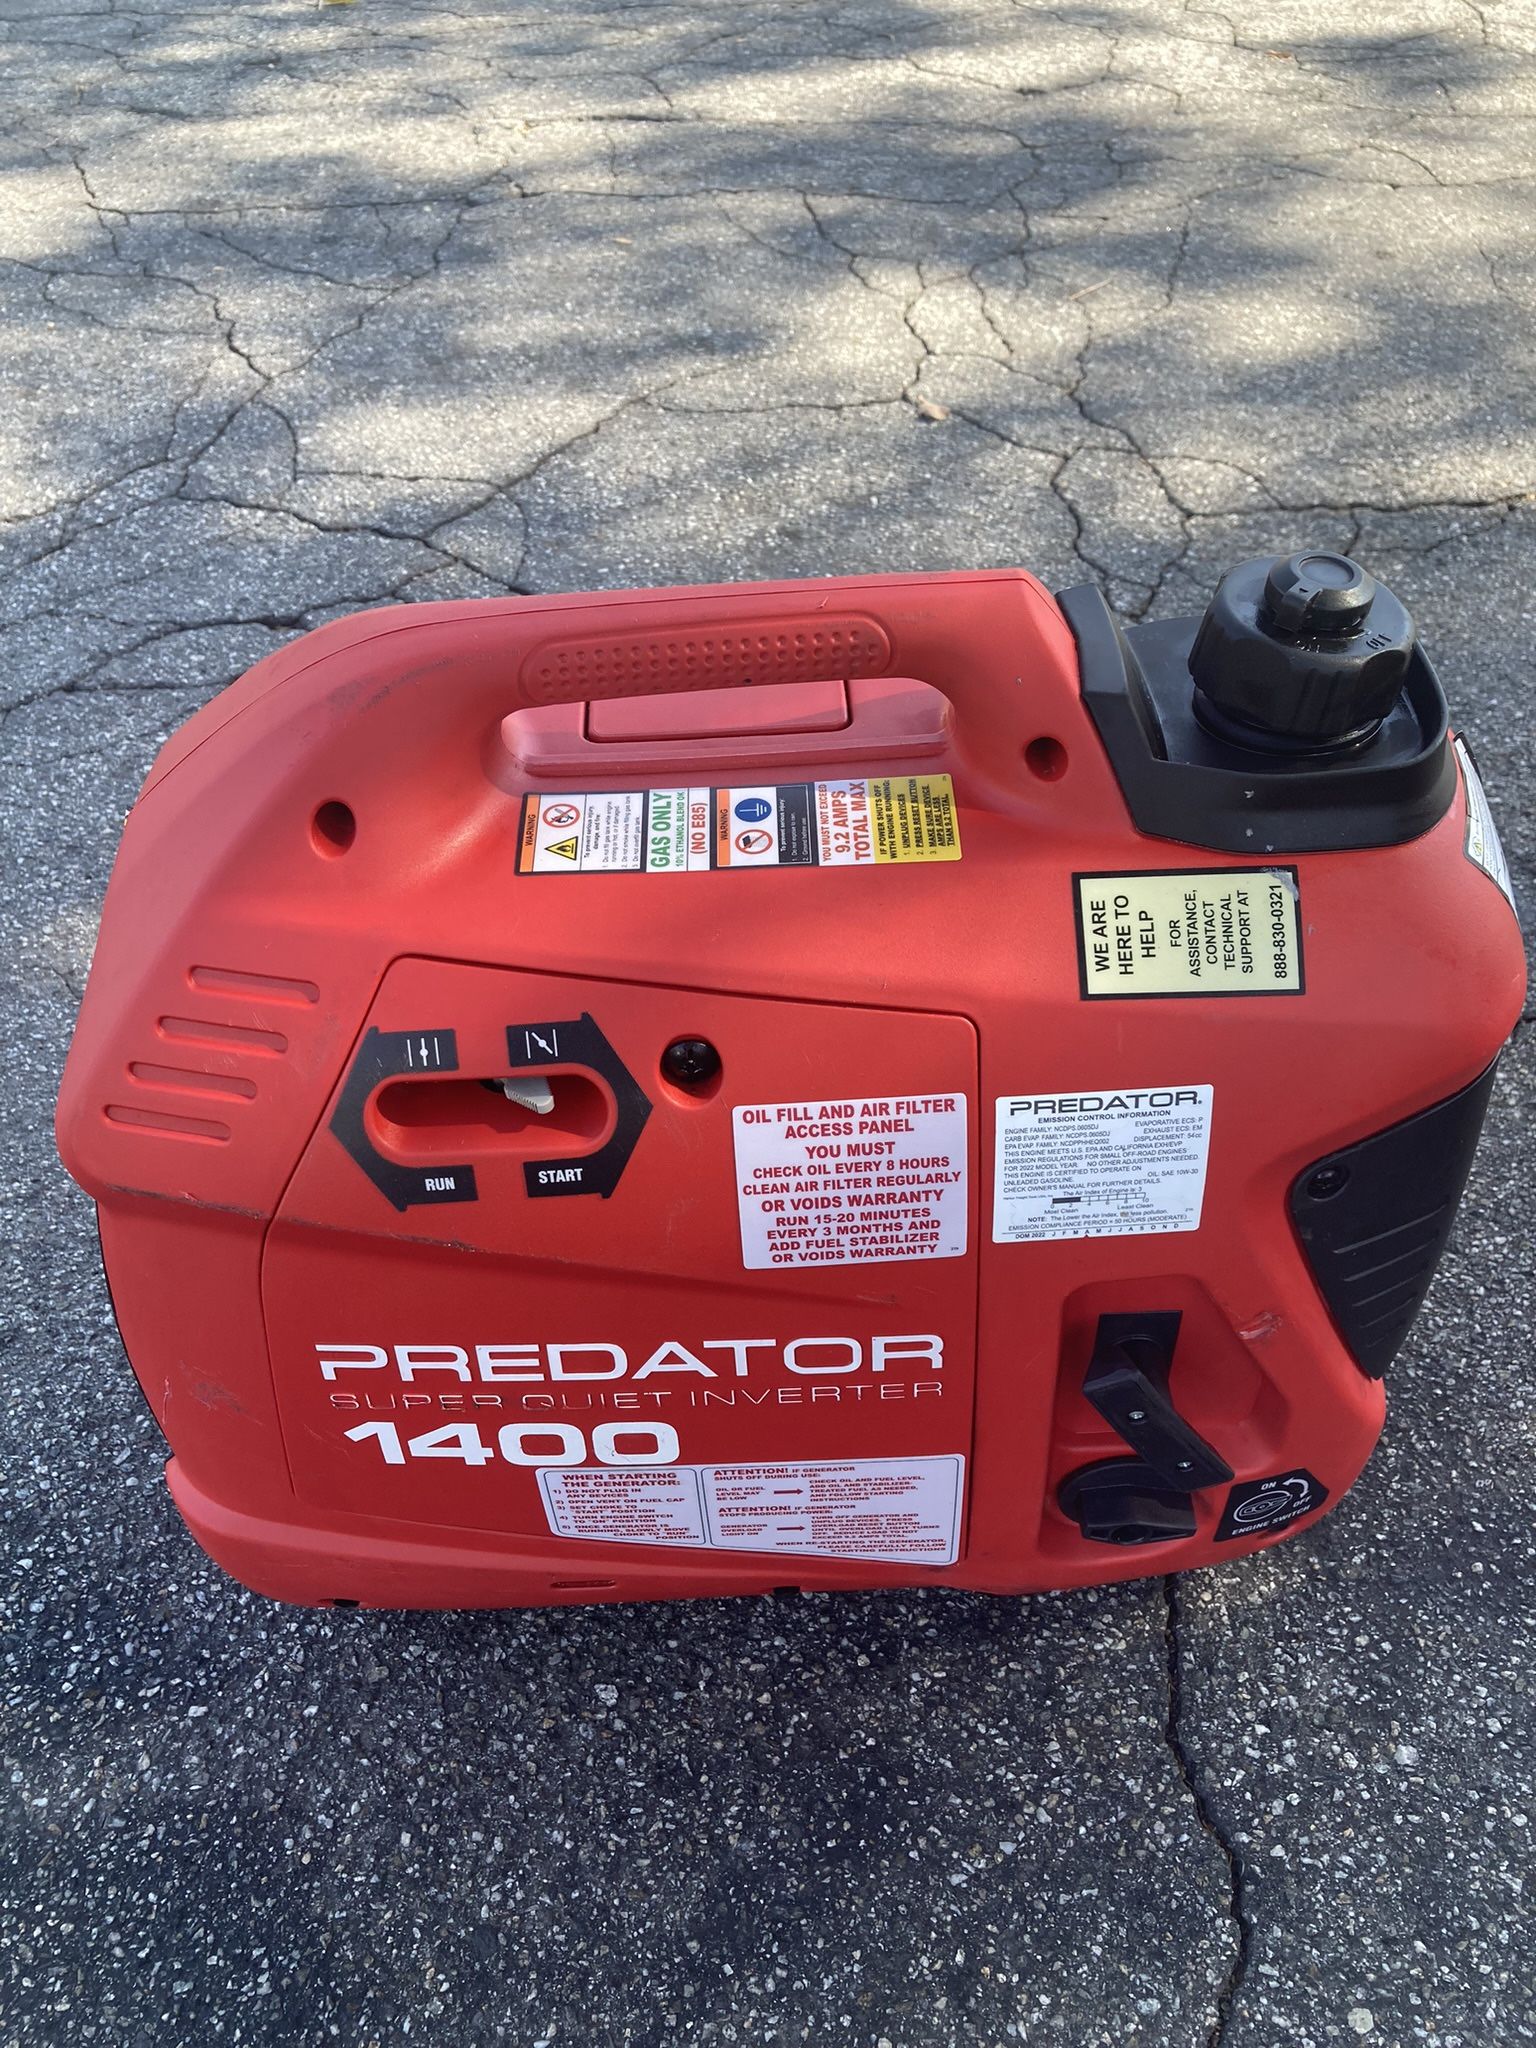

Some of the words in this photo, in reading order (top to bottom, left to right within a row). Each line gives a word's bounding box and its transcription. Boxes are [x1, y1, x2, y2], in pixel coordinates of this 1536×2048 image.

[677, 791, 684, 800] OK
[818, 784, 828, 809] EXCEED
[849, 781, 866, 810] MAX
[873, 784, 881, 797] OFF
[908, 778, 918, 803] BUTTON
[651, 792, 671, 831] ONLY
[676, 802, 684, 821] BLEND
[690, 802, 707, 828] E85)
[830, 790, 848, 828] AMPS
[875, 798, 883, 820] SHUTS
[897, 793, 907, 819] DEVICES
[911, 804, 920, 824] RESET
[932, 796, 941, 812] LESS
[820, 810, 829, 824] NOT
[886, 813, 895, 838] ENGINE
[924, 809, 934, 826] SURE
[934, 814, 943, 826] ARE
[943, 816, 952, 826] 9.2
[525, 814, 536, 846] WARNING
[676, 823, 684, 852] ETHANOL
[821, 826, 830, 845] MUST
[833, 831, 850, 852] 9.2
[851, 815, 871, 860] TOTAL
[877, 822, 886, 846] POWER
[900, 821, 910, 848] UNPLUG
[913, 826, 923, 847] PRESS
[927, 828, 936, 846] MAKE
[936, 828, 946, 846] AMPS
[945, 827, 955, 846] THAN
[650, 836, 670, 867] GAS
[690, 832, 707, 854] (NO
[822, 847, 831, 861] YOU
[889, 840, 897, 858] WITH
[675, 854, 683, 866] 10%
[1114, 895, 1129, 919] TO
[1237, 889, 1249, 906] AT
[1090, 900, 1107, 937] ARE
[1139, 910, 1155, 957] HELP
[1169, 919, 1181, 946] FOR
[1184, 889, 1202, 976] ASSISTANCE,
[1203, 900, 1218, 964] CONTACT
[1219, 893, 1236, 969] TECHNICAL
[1238, 909, 1253, 973] SUPPORT
[1269, 885, 1287, 978] 888-830-0321
[1093, 943, 1110, 971] WE
[1116, 925, 1133, 974] HERE
[742, 1109, 771, 1124] OIL
[776, 1106, 813, 1122] FILL
[818, 1104, 854, 1120] AND
[860, 1102, 889, 1117] AIR
[895, 1098, 955, 1115] FILTER
[784, 1121, 852, 1139] ACCESS
[858, 1118, 914, 1134] PANEL
[805, 1144, 840, 1159] YOU
[847, 1141, 895, 1157] MUST
[538, 1168, 583, 1184] START
[752, 1165, 802, 1179] CHECK
[806, 1163, 830, 1175] OIL
[835, 1160, 882, 1174] EVERY
[886, 1159, 894, 1170] 8
[899, 1156, 949, 1170] HOURS
[425, 1177, 455, 1191] RUN
[742, 1182, 789, 1195] CLEAN
[794, 1180, 818, 1192] AIR
[823, 1177, 871, 1190] FILTER
[876, 1171, 961, 1187] REGULARLY
[761, 1199, 785, 1212] OR
[790, 1195, 842, 1210] VOIDS
[847, 1189, 943, 1207] WARRANTY
[776, 1215, 808, 1227] RUN
[814, 1212, 854, 1224] 15-20
[860, 1207, 930, 1221] MINUTES
[767, 1227, 818, 1239] EVERY
[822, 1226, 831, 1236] 3
[836, 1221, 903, 1235] MONTHS
[907, 1219, 940, 1231] AND
[768, 1241, 800, 1251] ADD
[805, 1238, 844, 1249] FUEL
[849, 1232, 939, 1246] STABILIZER
[771, 1253, 793, 1262] OR
[798, 1250, 844, 1261] VOIDS
[849, 1244, 937, 1258] WARRANTY
[315, 1335, 944, 1382] PREDATOR
[329, 1393, 503, 1411] SUPER
[522, 1390, 671, 1410] QUIET
[690, 1381, 942, 1407] INVERTER
[343, 1420, 680, 1466] 1400
[713, 1468, 788, 1476] ATTENTION!
[1261, 1481, 1276, 1490] ON
[1293, 1495, 1312, 1508] OFF
[1231, 1520, 1270, 1536] ENGINE
[1271, 1504, 1311, 1525] SWITCH
